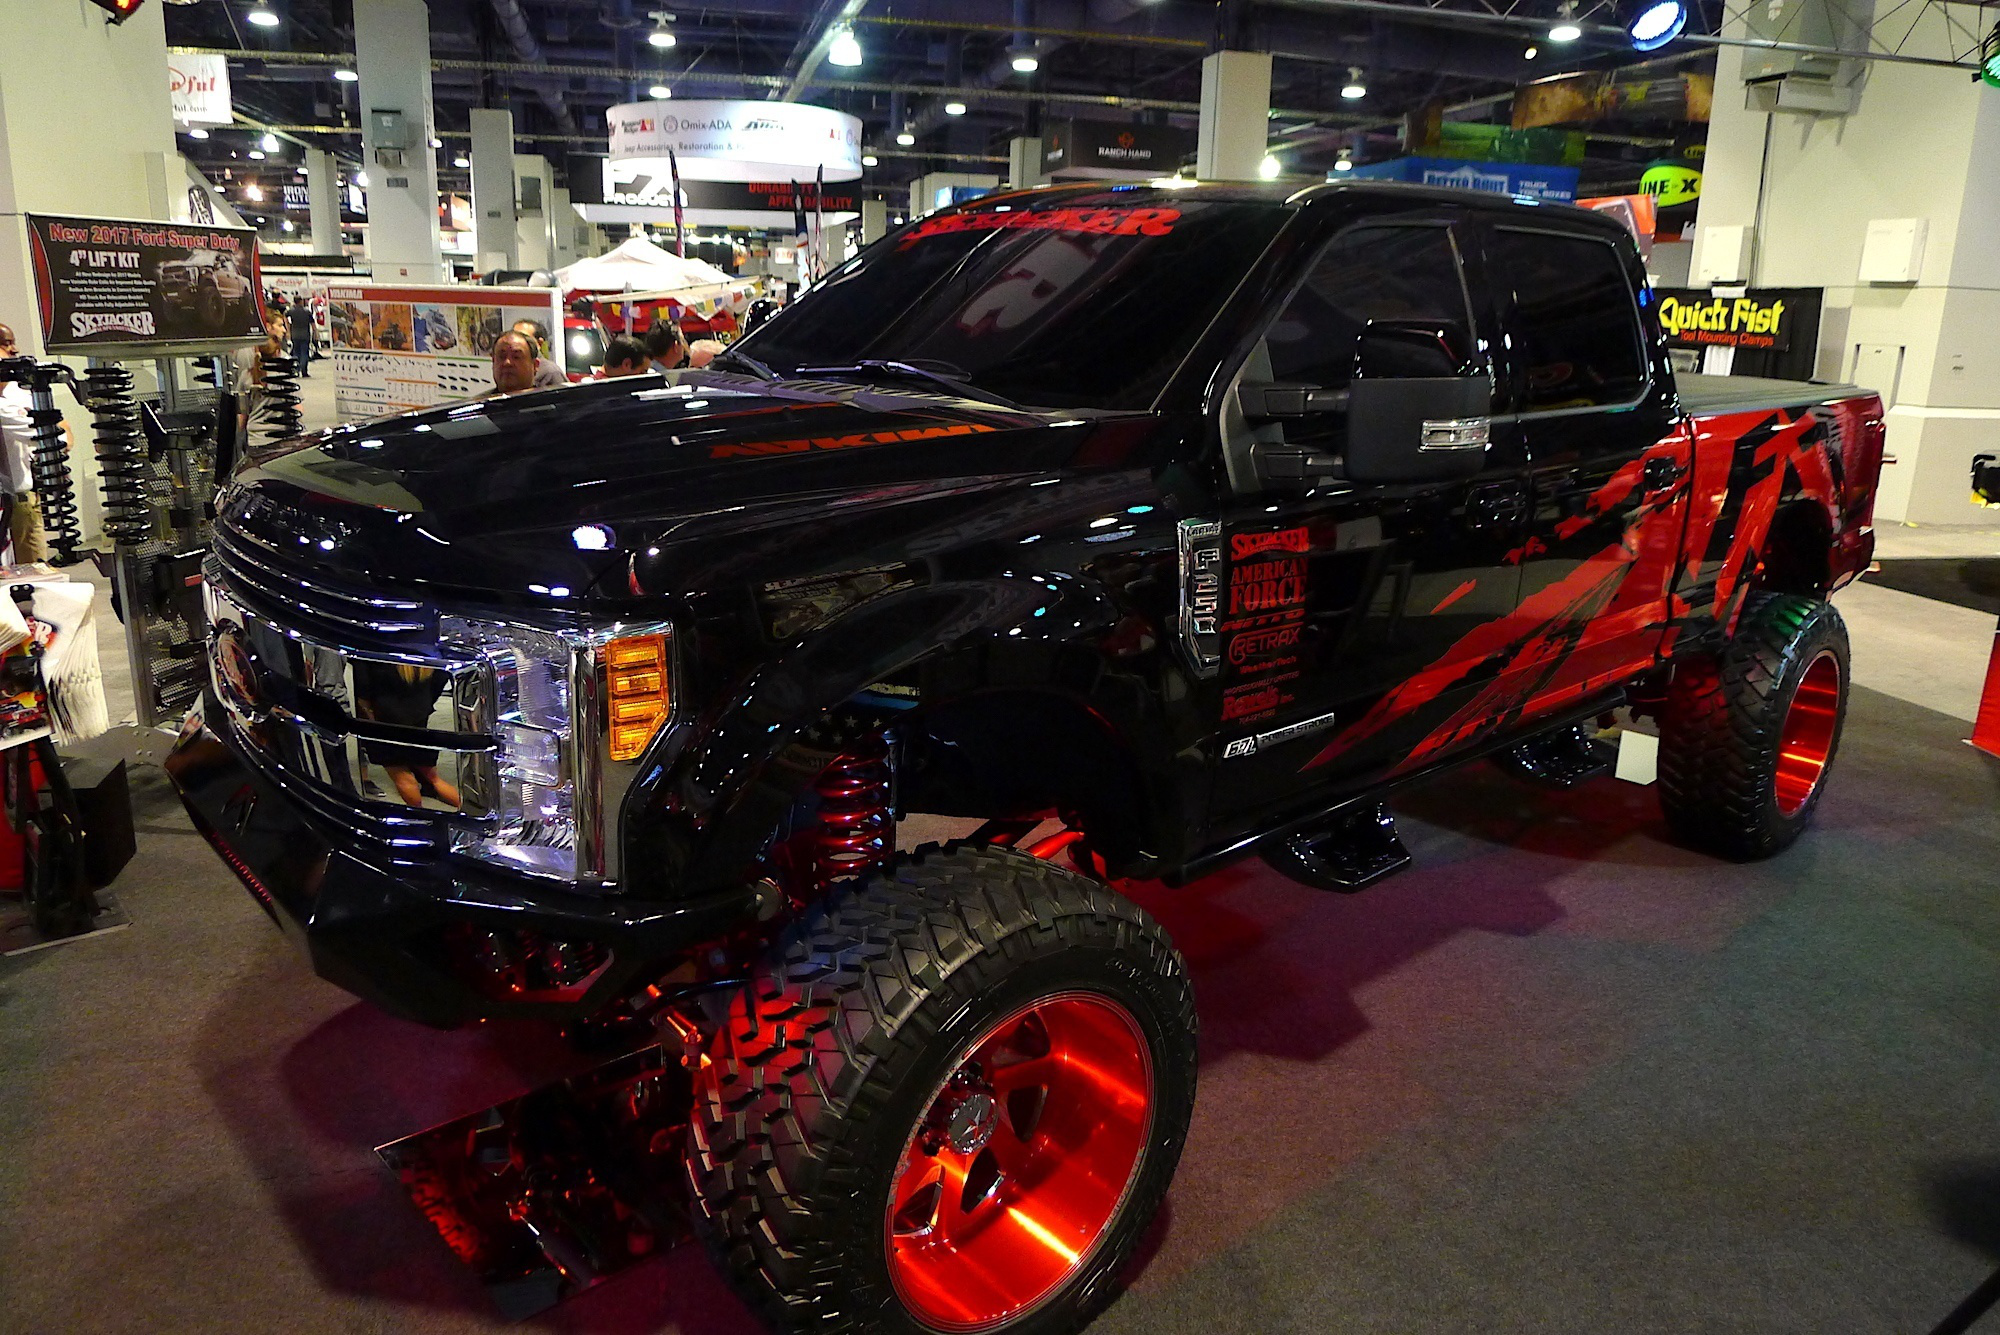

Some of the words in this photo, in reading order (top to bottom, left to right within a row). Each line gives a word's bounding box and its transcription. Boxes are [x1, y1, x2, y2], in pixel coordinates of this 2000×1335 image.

[680, 119, 733, 131] Omix-ADA
[678, 142, 724, 151] Restoration
[1098, 146, 1128, 157] RANCH
[1128, 148, 1152, 159] HAND
[748, 182, 815, 195] DURABITY
[1519, 180, 1548, 189] TRUCK
[1640, 178, 1698, 195] INE-X
[602, 192, 689, 207] PRODUCS
[768, 194, 853, 210] AFFODAILITY
[1542, 190, 1572, 200] BOXES
[49, 222, 88, 242] New
[91, 225, 130, 245] 2017
[133, 229, 166, 247] Ford
[168, 231, 208, 251] Super
[210, 233, 240, 250] Duty
[89, 252, 118, 268] LIFT
[118, 252, 141, 269] KIT
[330, 288, 363, 300] YAKIMA
[70, 311, 156, 338] SKYJACKER
[1658, 296, 1730, 336] Quick
[1730, 298, 1785, 335] Fist
[1680, 329, 1696, 341] Tool
[1697, 330, 1738, 347] Mounting
[1739, 332, 1775, 348] Clamps
[1230, 526, 1310, 561] SKYJACKER
[1229, 557, 1308, 585] AMERICAN
[1228, 576, 1308, 615] FORCE
[1220, 608, 1306, 633] NITTO
[1230, 626, 1302, 660] RETRAX
[1261, 727, 1295, 744] POWER
[1296, 715, 1334, 734] STROKE
